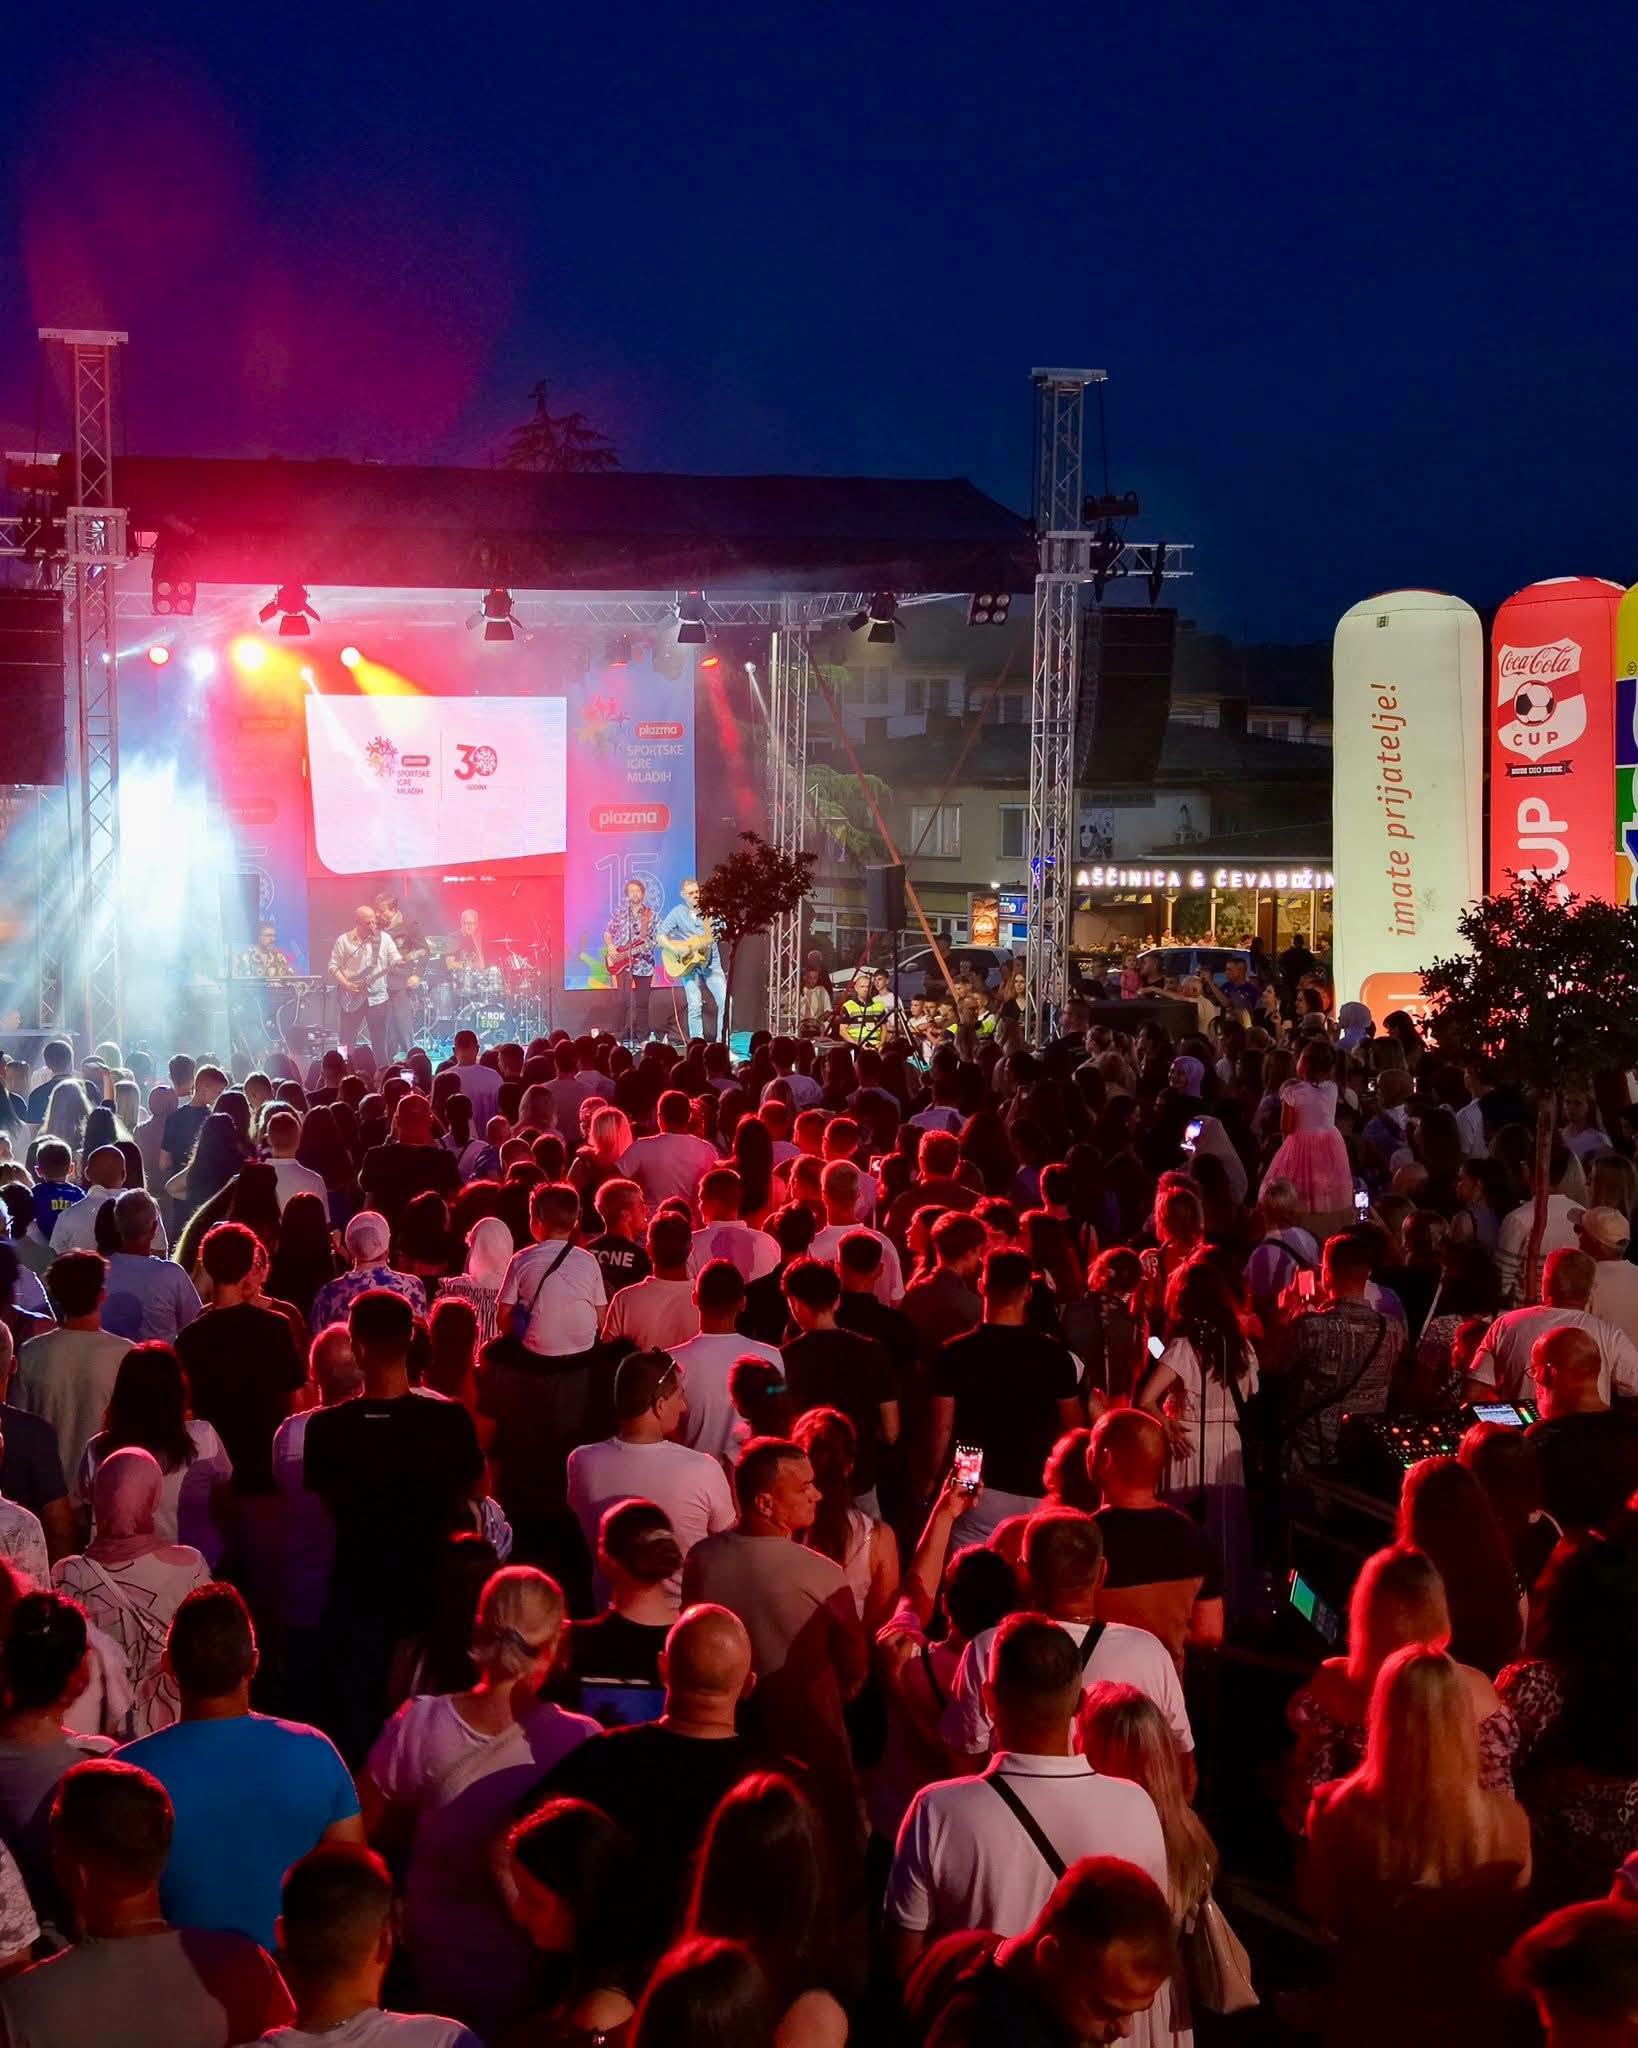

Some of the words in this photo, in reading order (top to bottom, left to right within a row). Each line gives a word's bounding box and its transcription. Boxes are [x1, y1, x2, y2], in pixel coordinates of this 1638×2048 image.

[1501, 646, 1574, 677] Coca-Cola
[639, 725, 677, 737] plazma
[1513, 732, 1558, 747] CUP
[627, 744, 684, 756] SPORTSKE
[627, 759, 652, 770] IGRE
[1371, 683, 1415, 840] prijatelje!
[627, 772, 672, 783] MLADIH
[600, 808, 657, 829] plazma
[1386, 850, 1416, 936] imate
